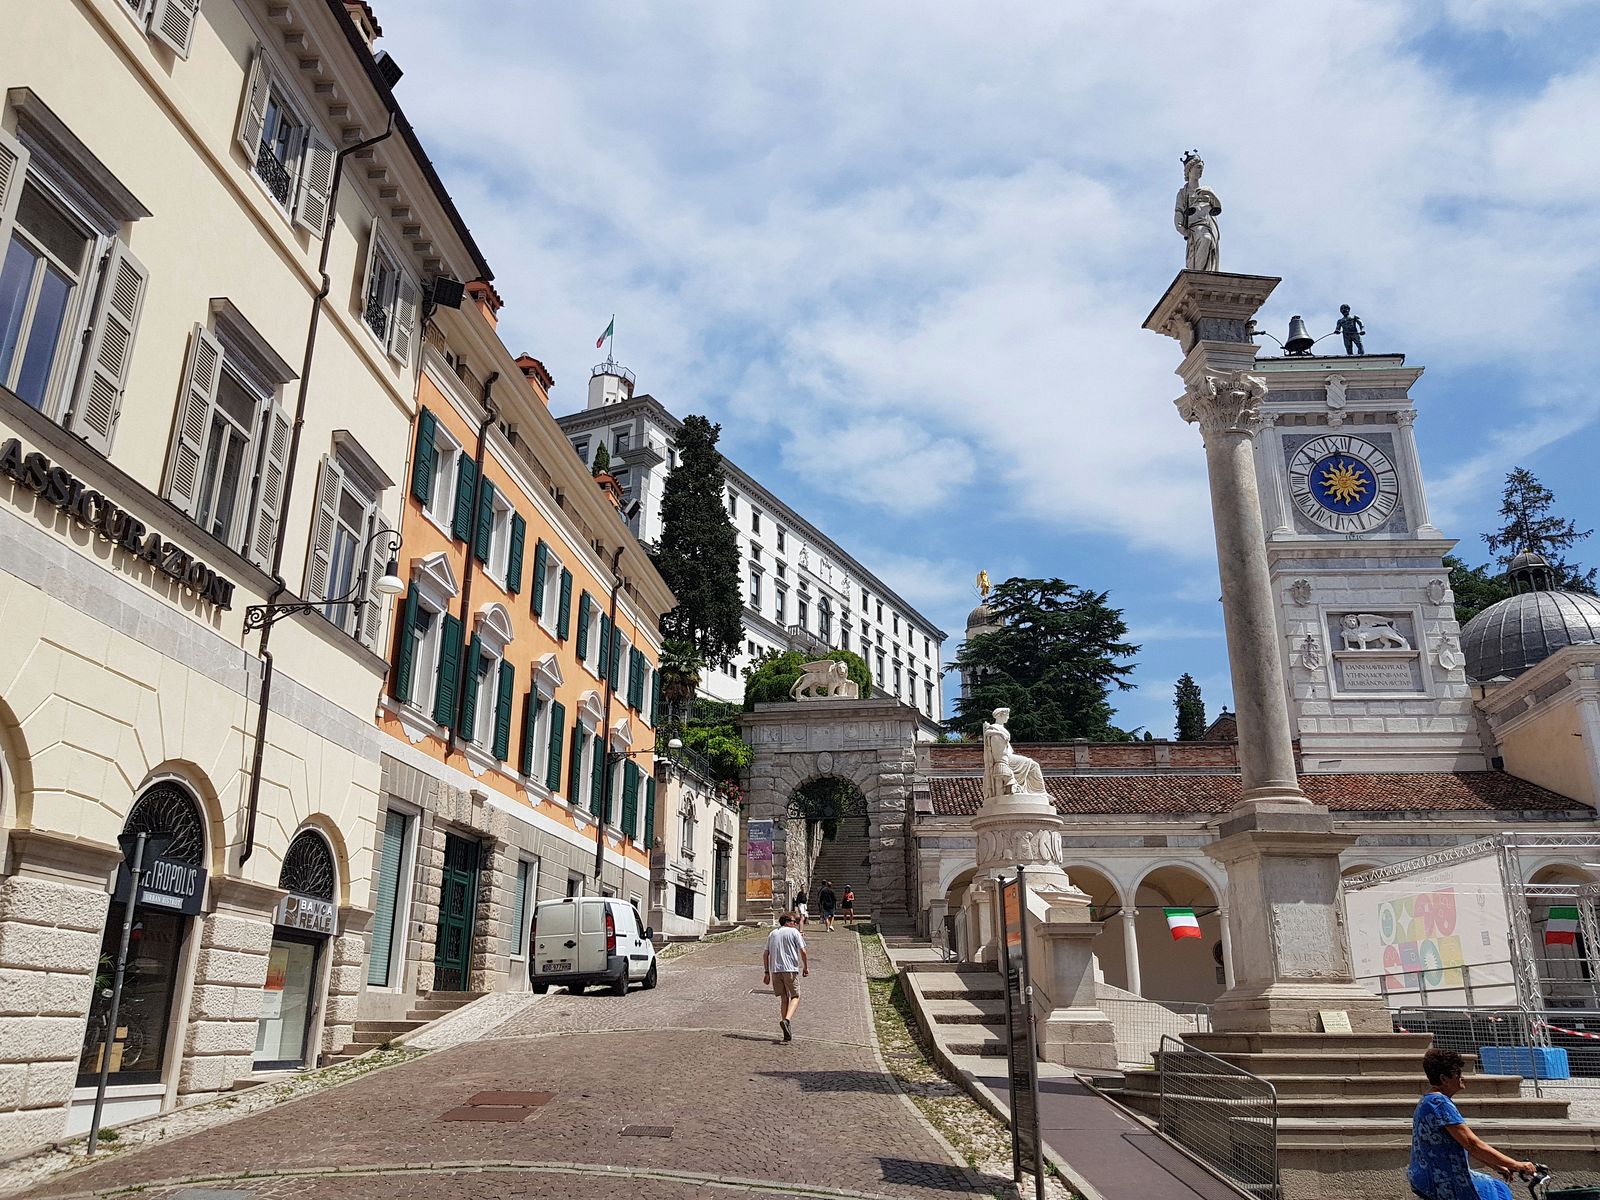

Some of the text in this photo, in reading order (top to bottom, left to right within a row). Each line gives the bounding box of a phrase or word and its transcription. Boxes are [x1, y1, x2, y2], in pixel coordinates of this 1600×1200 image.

[0, 437, 235, 611] ASSICURAZIONI
[300, 899, 333, 917] BANCA
[299, 912, 332, 932] REALE
